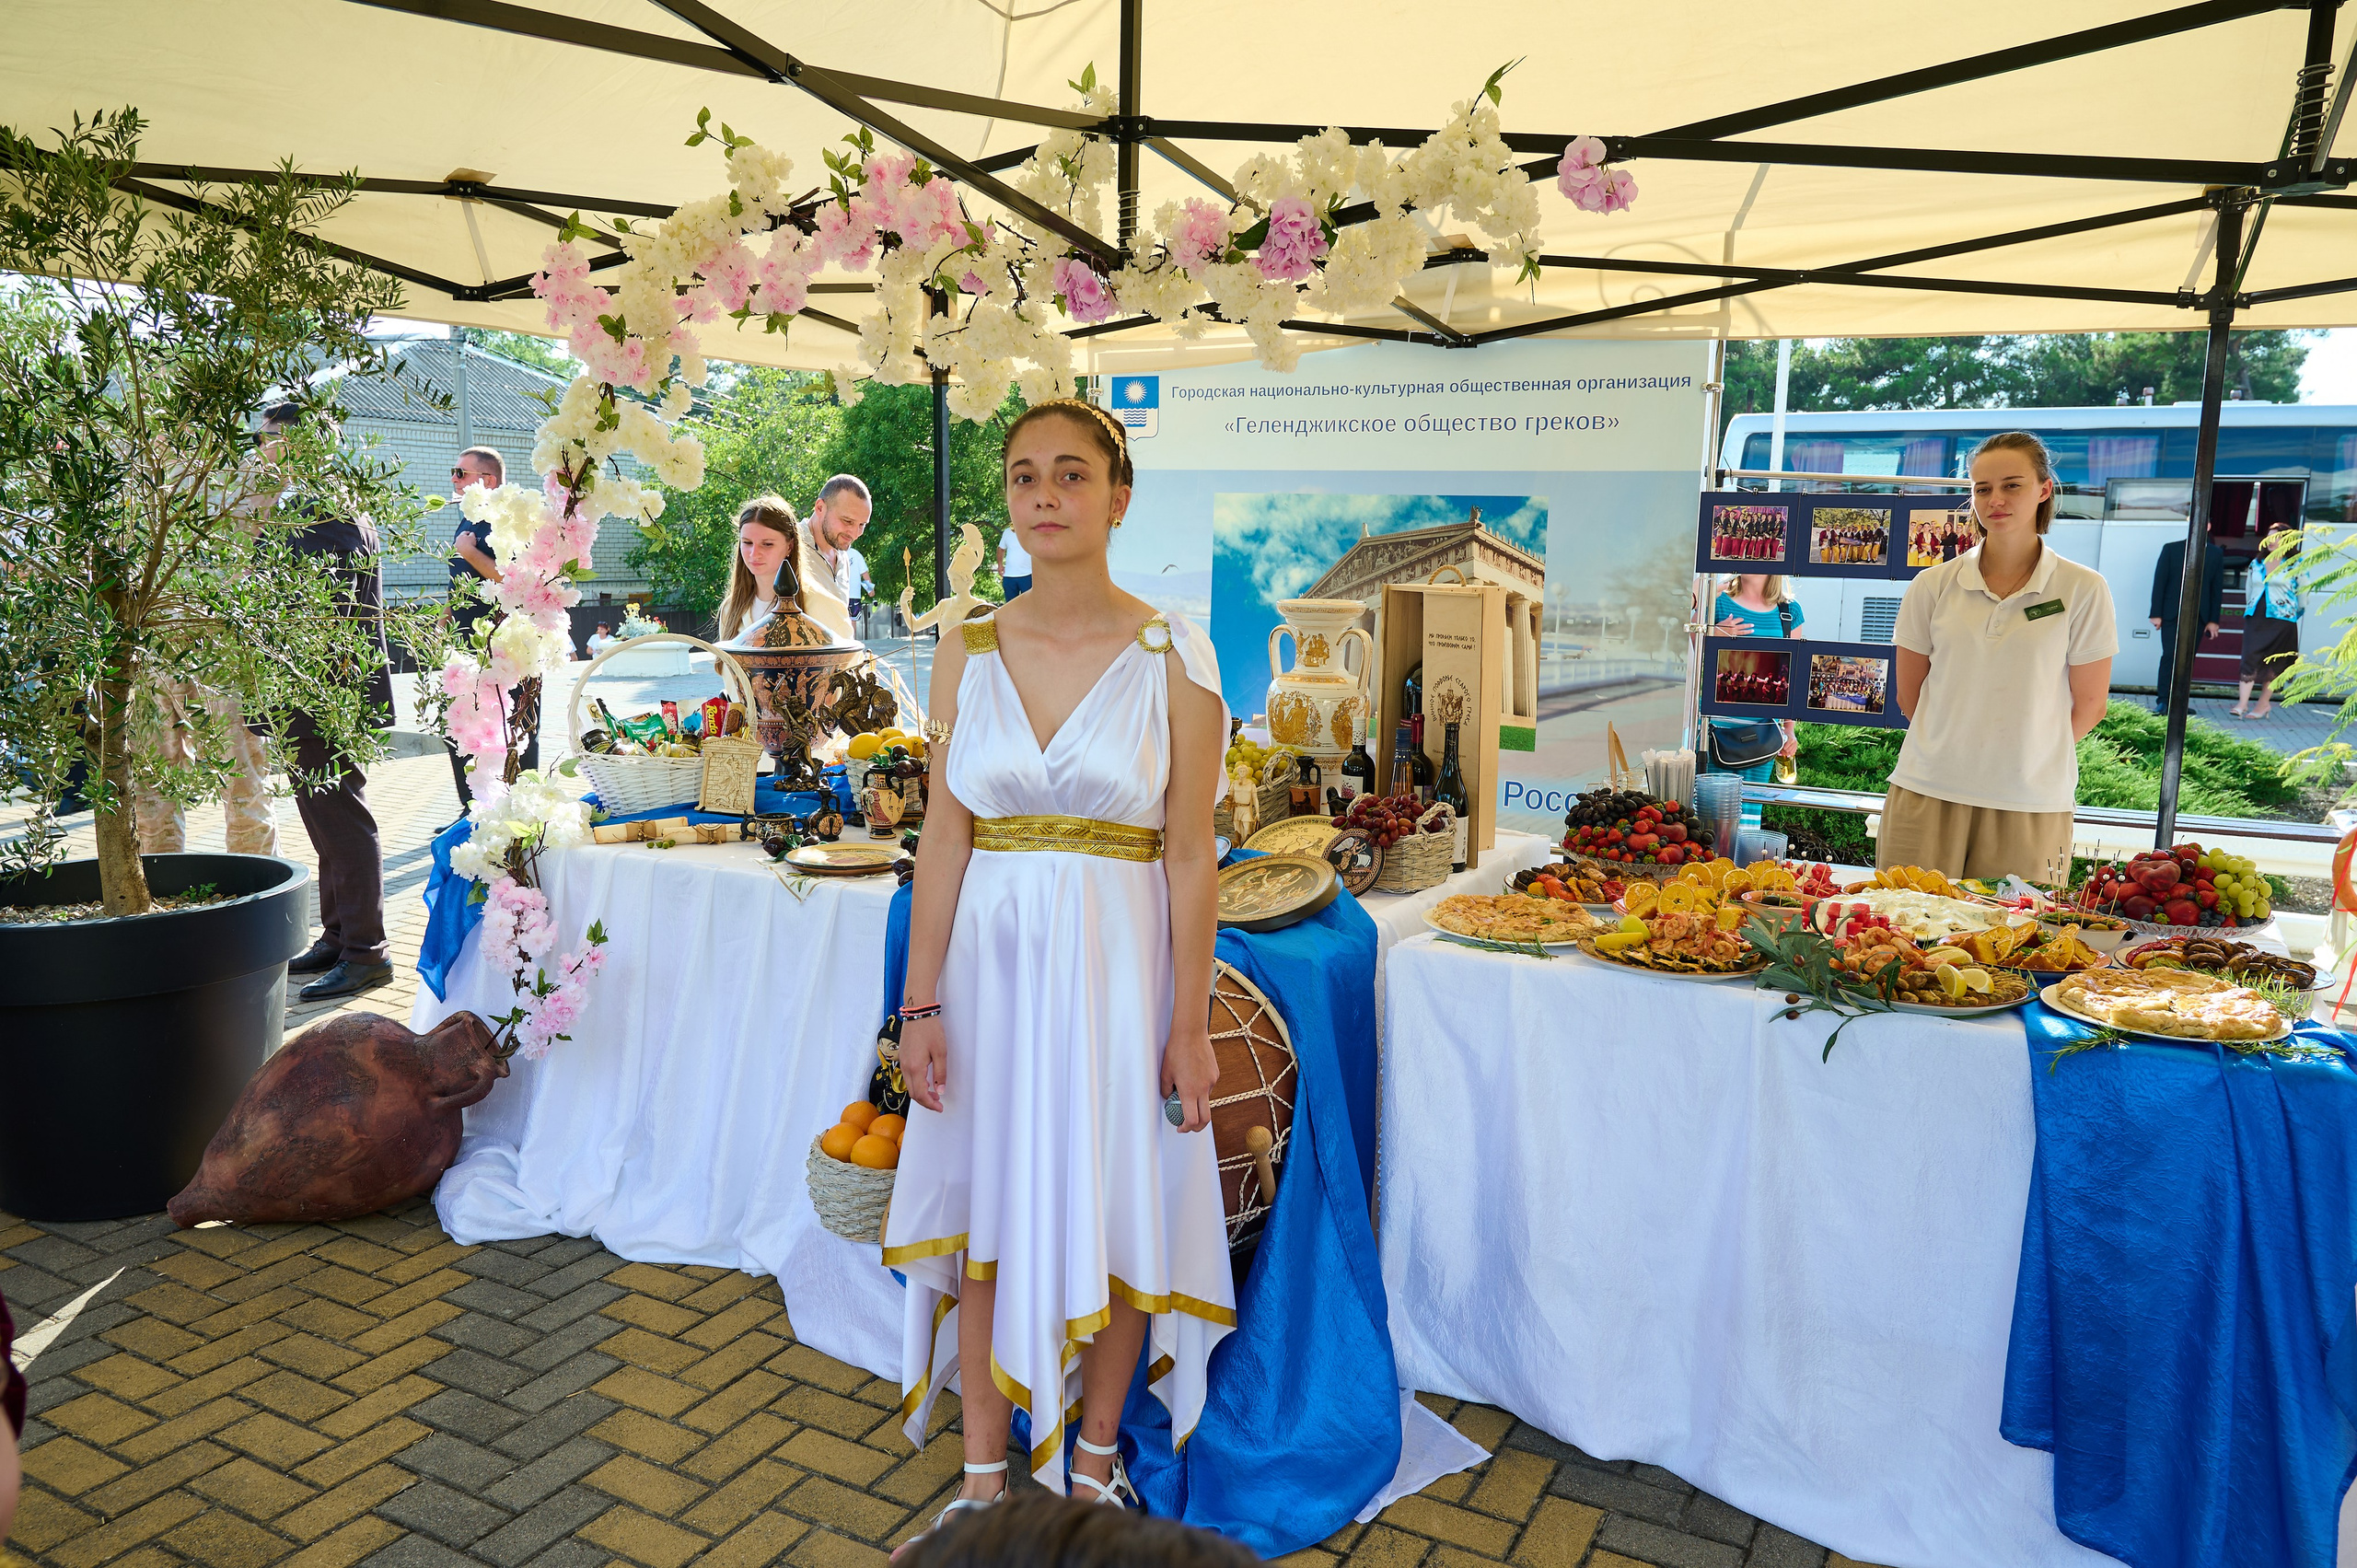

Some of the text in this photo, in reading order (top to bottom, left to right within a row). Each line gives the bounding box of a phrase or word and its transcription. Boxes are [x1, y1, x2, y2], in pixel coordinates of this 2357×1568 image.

[1171, 376, 1691, 401] Городская национально-культурная общественная организация
[1225, 413, 1620, 437] «Геленджикское общество греков»
[705, 704, 719, 735] Rondo
[1504, 781, 1578, 814] Росс
